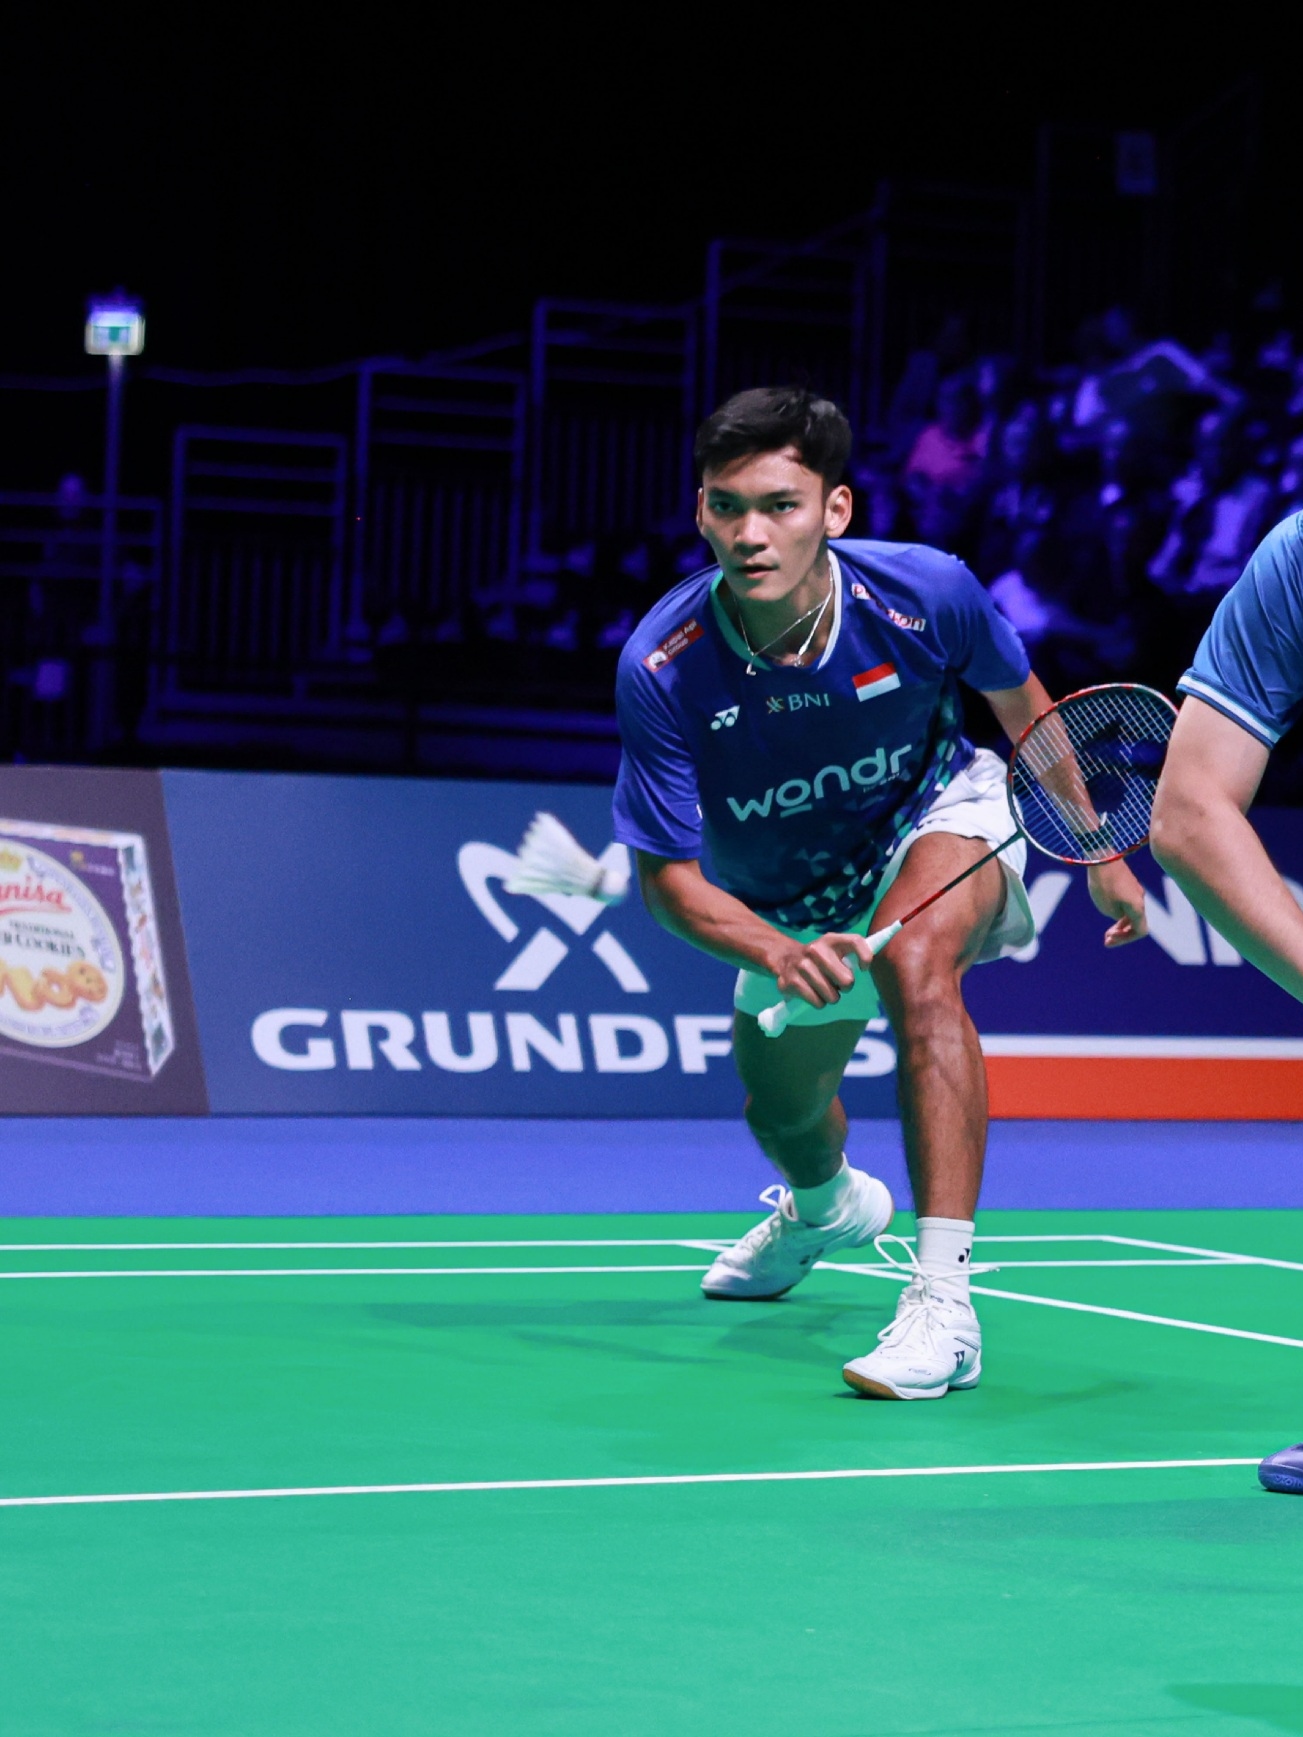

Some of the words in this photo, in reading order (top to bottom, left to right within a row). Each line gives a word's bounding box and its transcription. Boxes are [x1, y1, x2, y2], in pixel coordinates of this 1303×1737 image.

[787, 693, 830, 712] BNI
[727, 744, 912, 822] wondr
[0, 874, 68, 906] nisa
[251, 1007, 896, 1078] GRUNDFS
